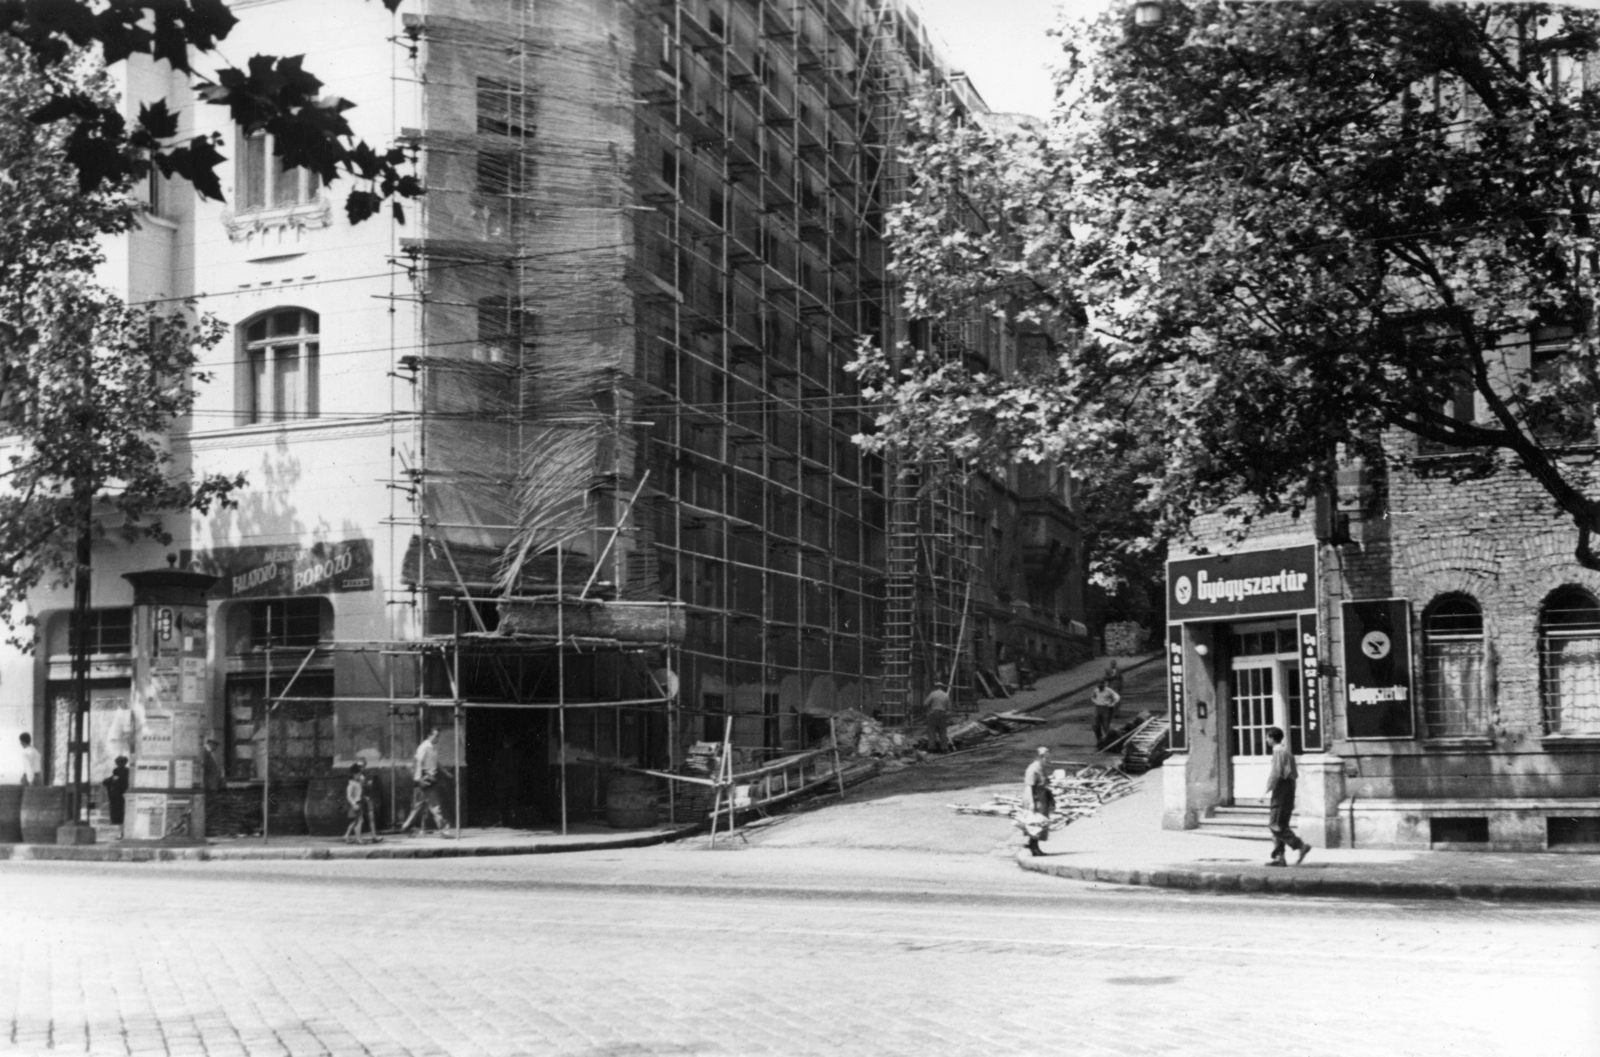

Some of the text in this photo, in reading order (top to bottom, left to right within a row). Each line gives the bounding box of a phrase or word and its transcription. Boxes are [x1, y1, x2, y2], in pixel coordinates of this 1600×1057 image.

[293, 547, 352, 591] BOROZÓ
[1197, 569, 1308, 604] Gyógyszertár
[1348, 683, 1408, 705] Gyógyszertár
